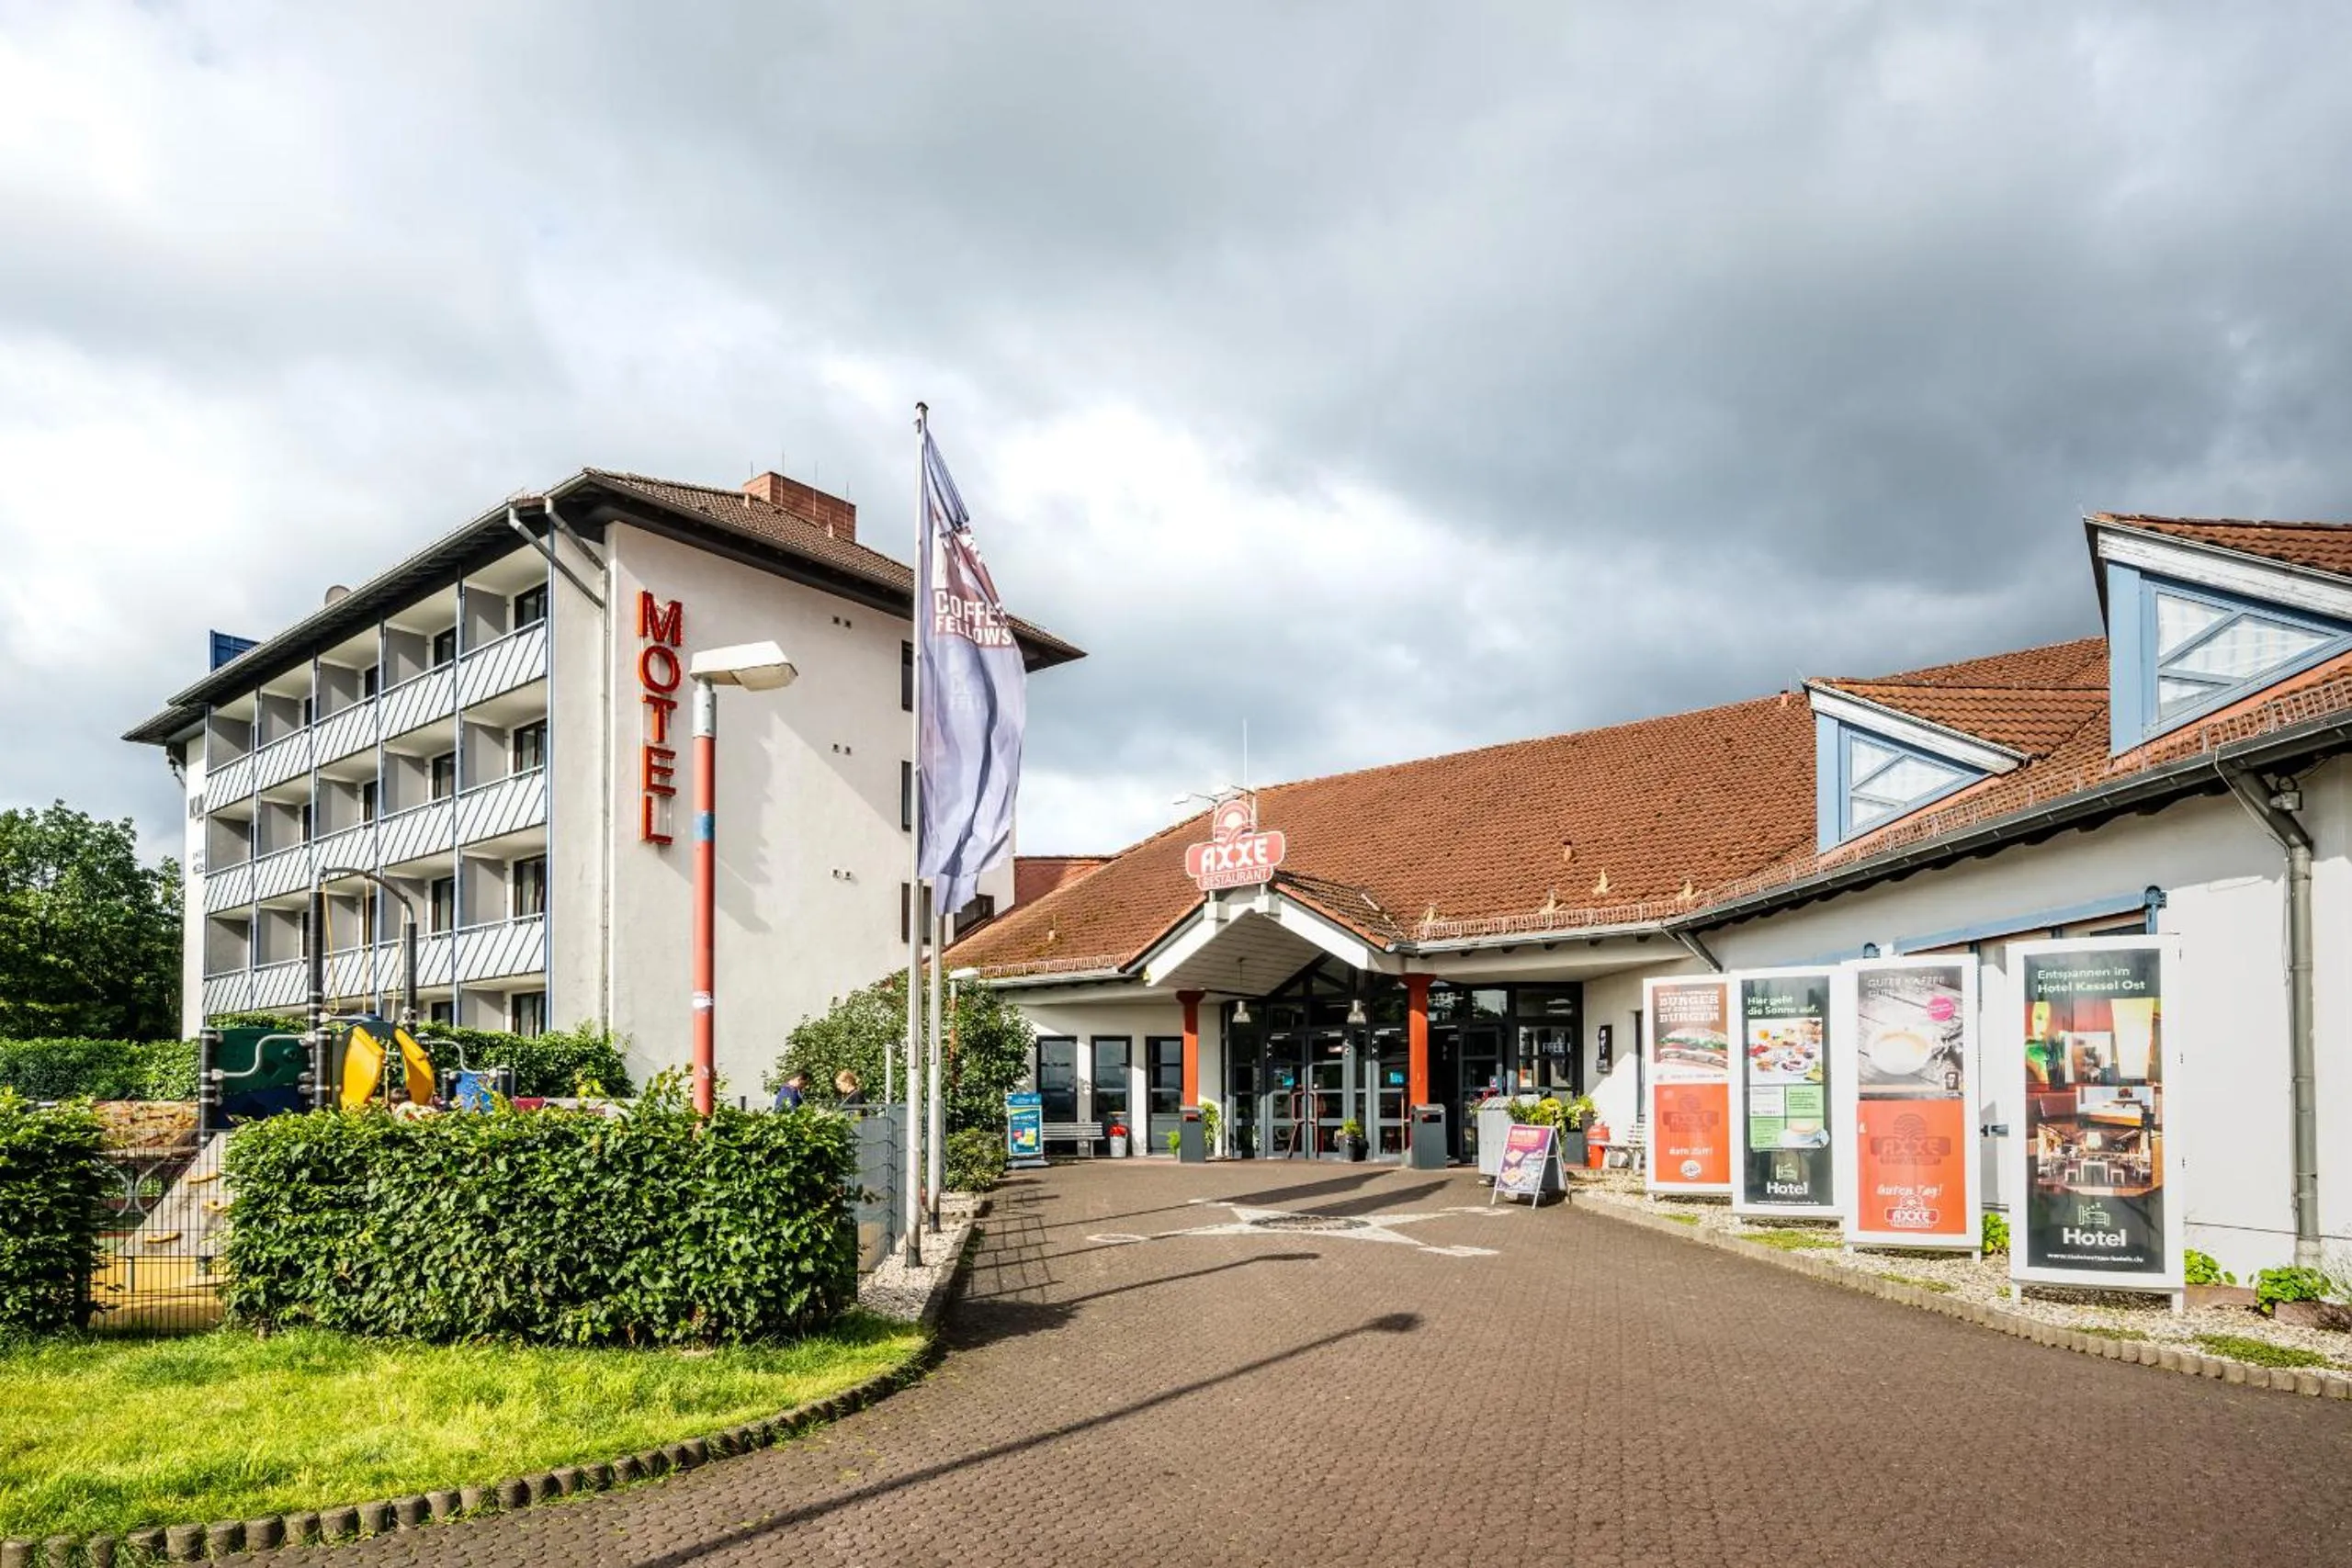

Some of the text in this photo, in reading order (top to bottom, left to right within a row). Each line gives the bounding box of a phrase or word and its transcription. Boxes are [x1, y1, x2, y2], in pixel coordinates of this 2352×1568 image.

[935, 616, 1012, 646] FELLOWS
[638, 591, 683, 845] MOTEL
[1201, 839, 1268, 874] AXXE
[1204, 868, 1268, 886] RESTAURANT
[2038, 967, 2130, 981] Entspannen im
[2038, 982, 2072, 993] Hotel
[2121, 980, 2145, 990] Ost
[1747, 997, 1768, 1005] Hier
[1747, 1006, 1763, 1015] die
[1765, 1006, 1796, 1015] Sonne
[1767, 1181, 1808, 1195] Hotel
[2063, 1227, 2127, 1247] Hotel
